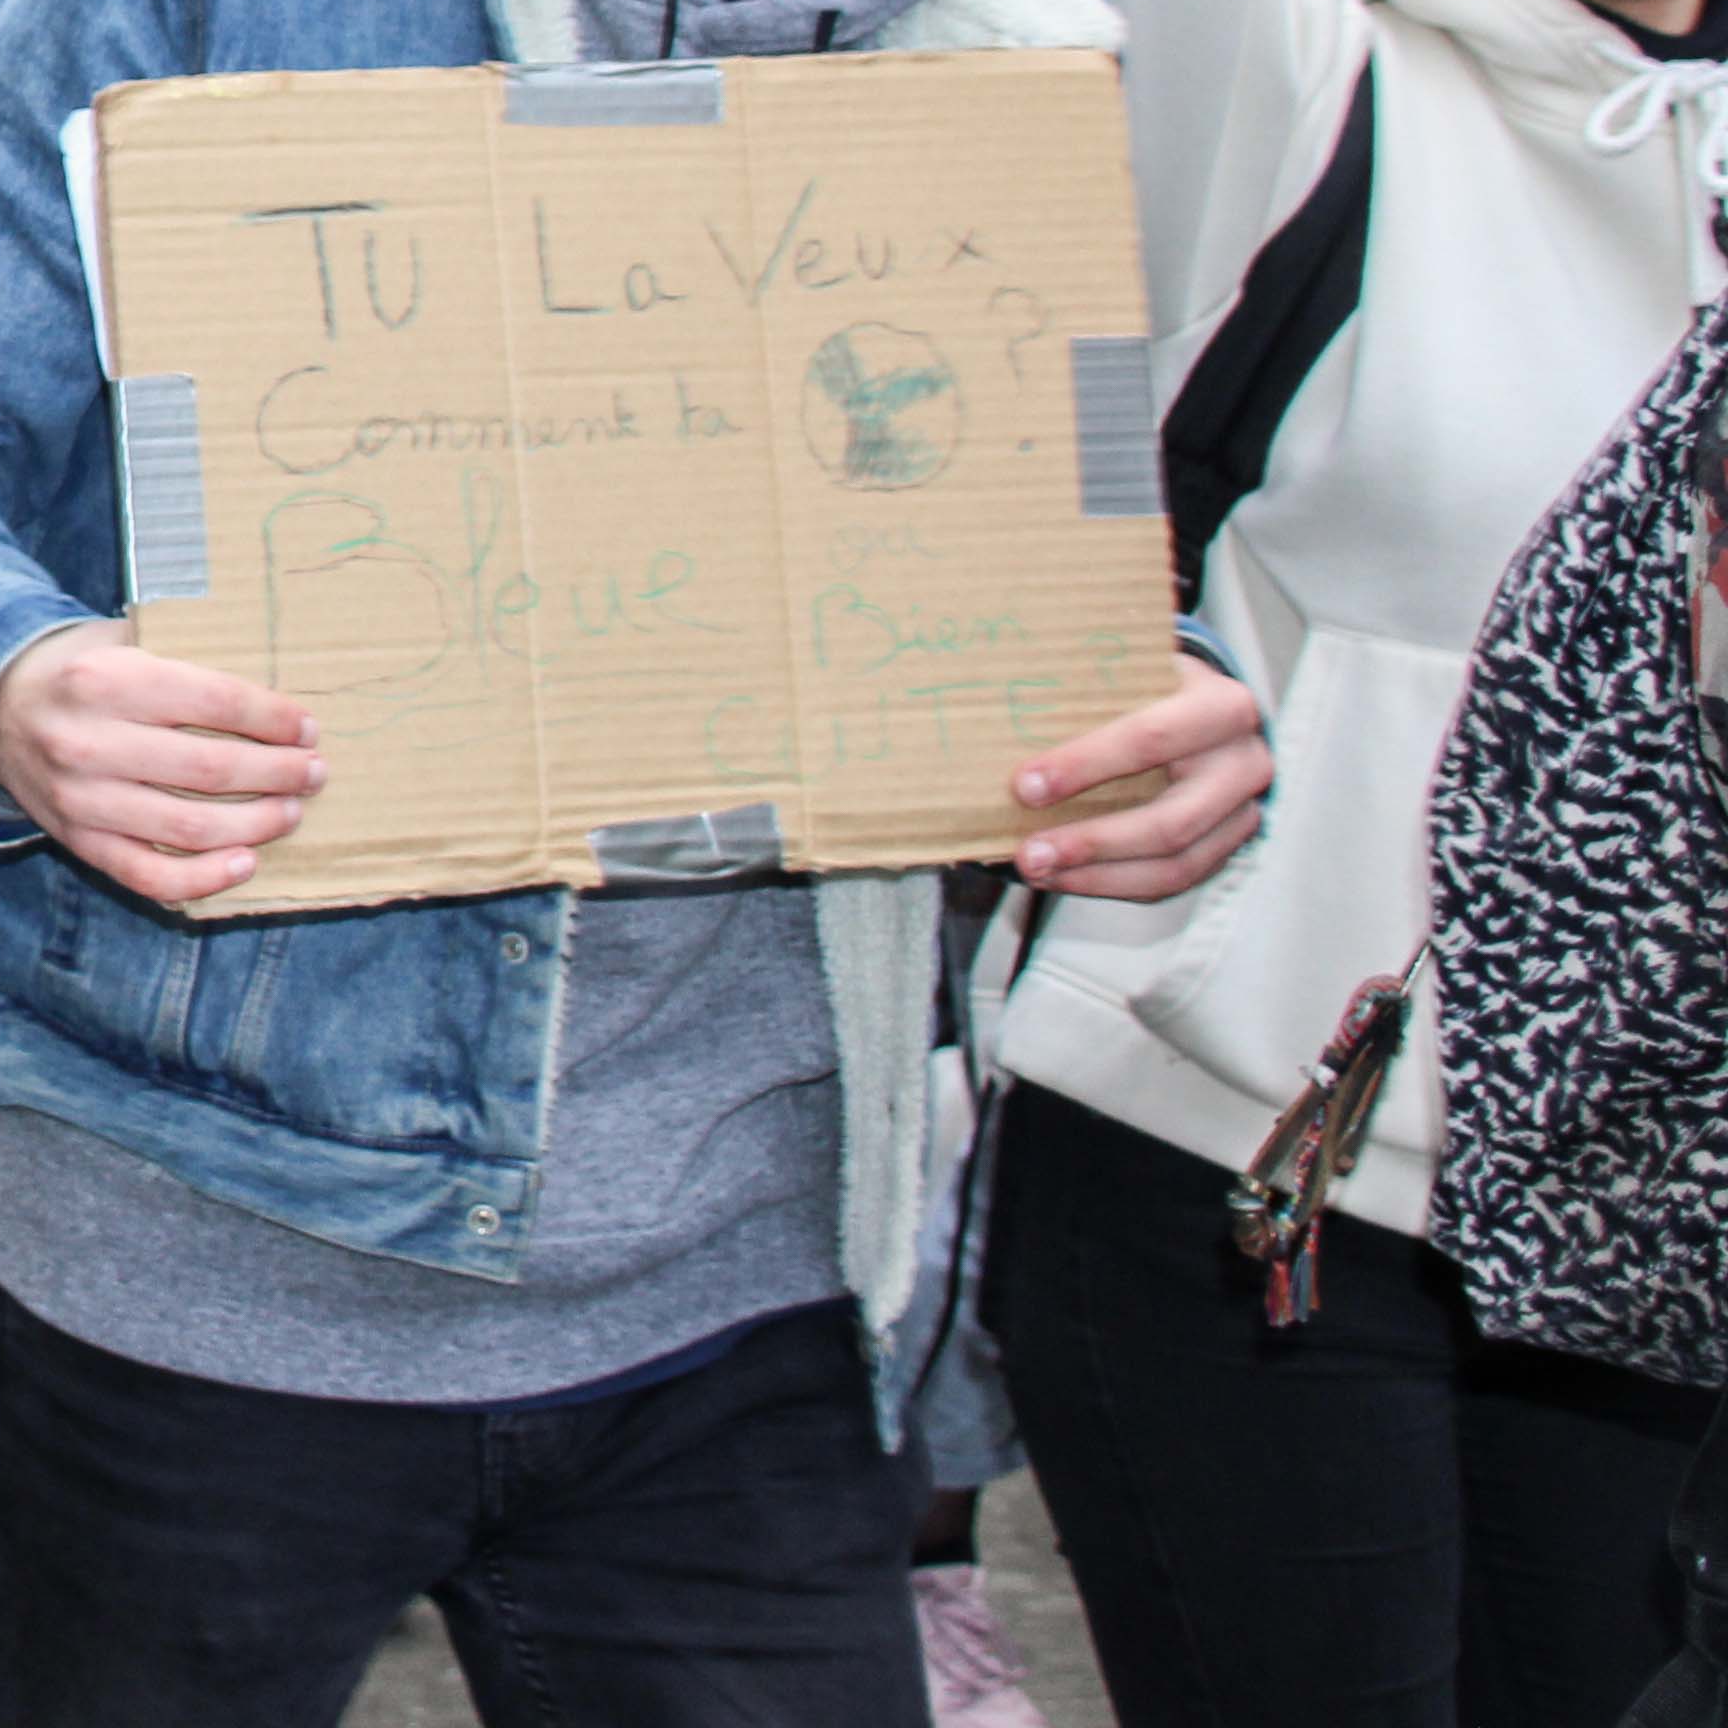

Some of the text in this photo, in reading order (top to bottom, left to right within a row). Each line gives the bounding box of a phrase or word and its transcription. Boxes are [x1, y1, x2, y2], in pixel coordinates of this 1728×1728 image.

[531, 196, 689, 316] La
[255, 364, 642, 475] Comment
[812, 583, 1031, 670] Bien
